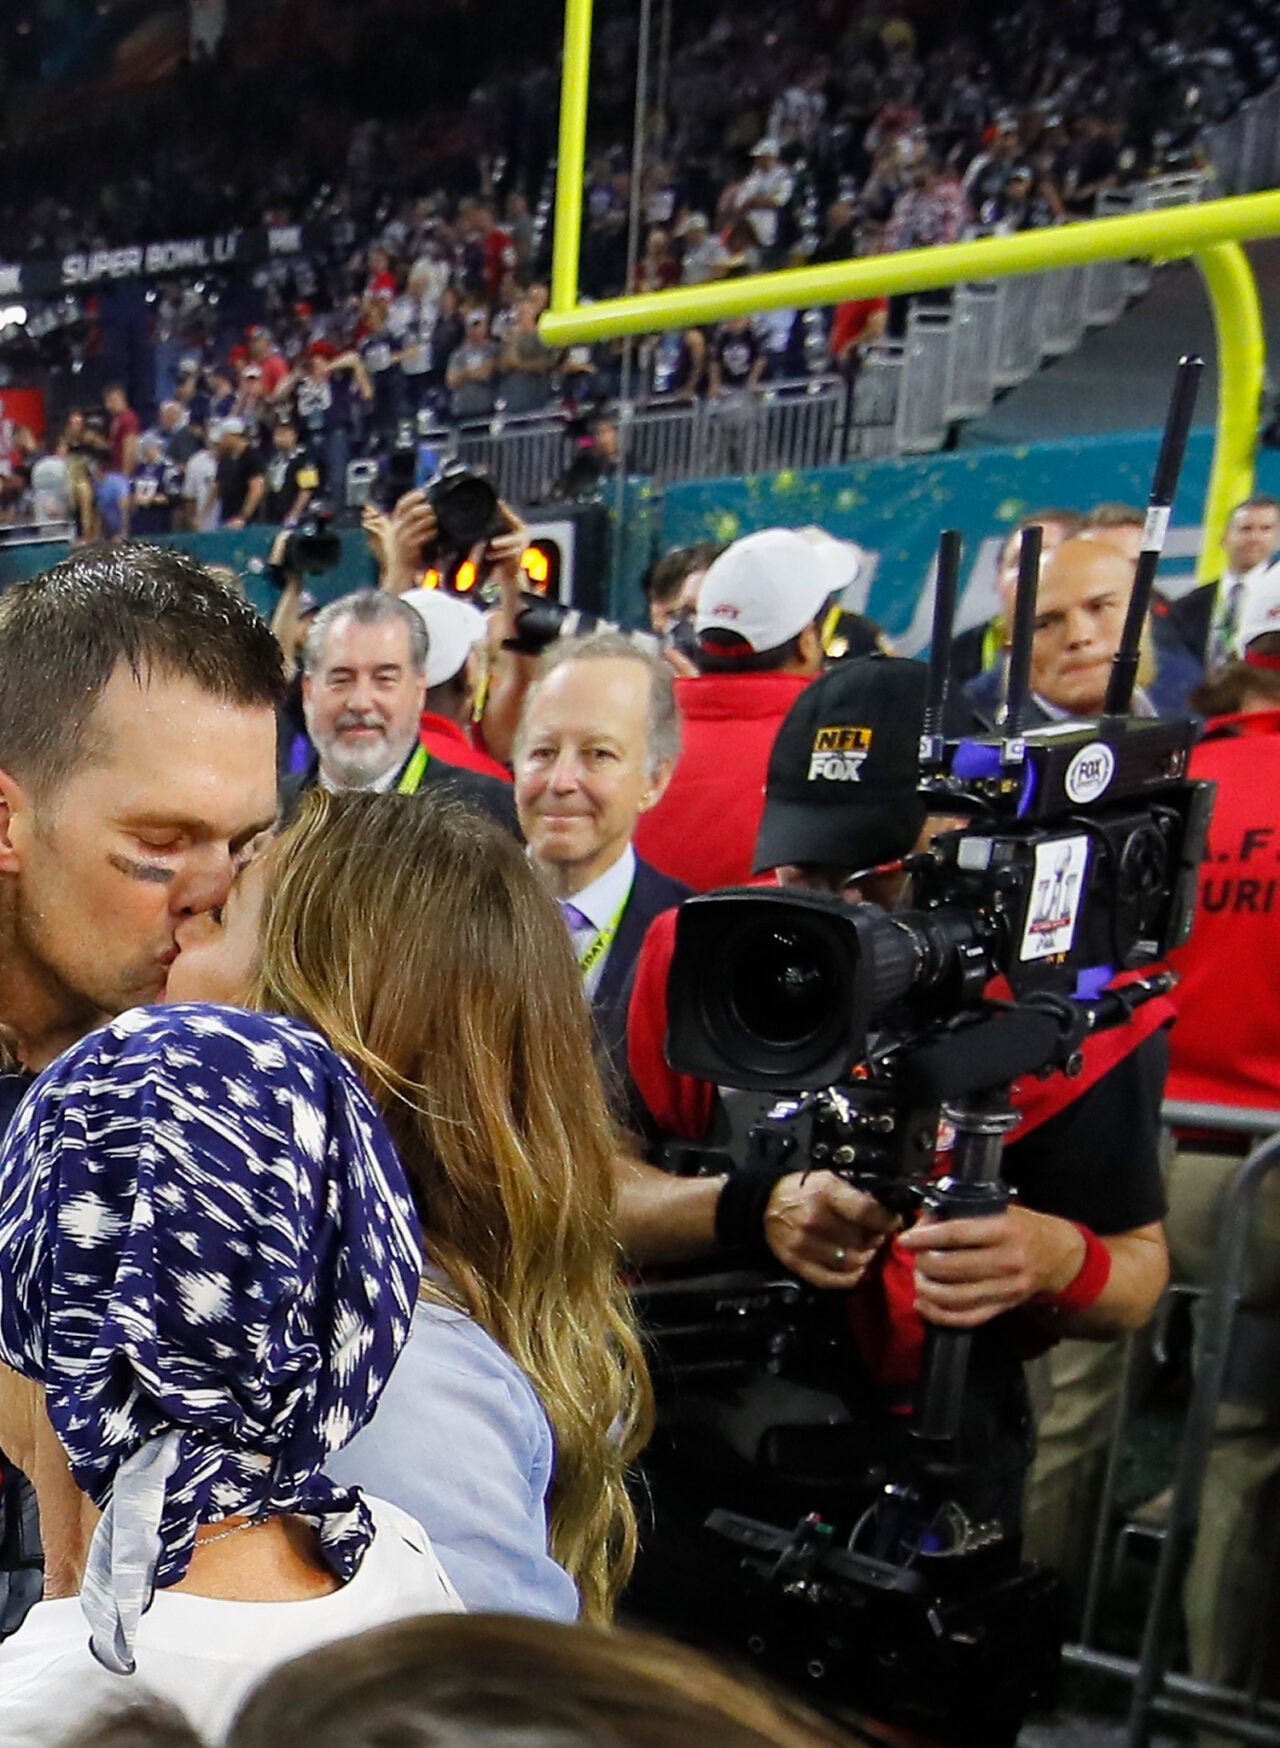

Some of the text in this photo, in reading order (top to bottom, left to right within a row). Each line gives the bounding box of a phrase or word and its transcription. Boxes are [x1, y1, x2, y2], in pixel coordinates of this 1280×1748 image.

[61, 246, 143, 285] SUPER
[145, 237, 210, 272] BOWL
[817, 730, 867, 751] NFL
[808, 759, 862, 782] FOX
[1079, 757, 1102, 780] FOX
